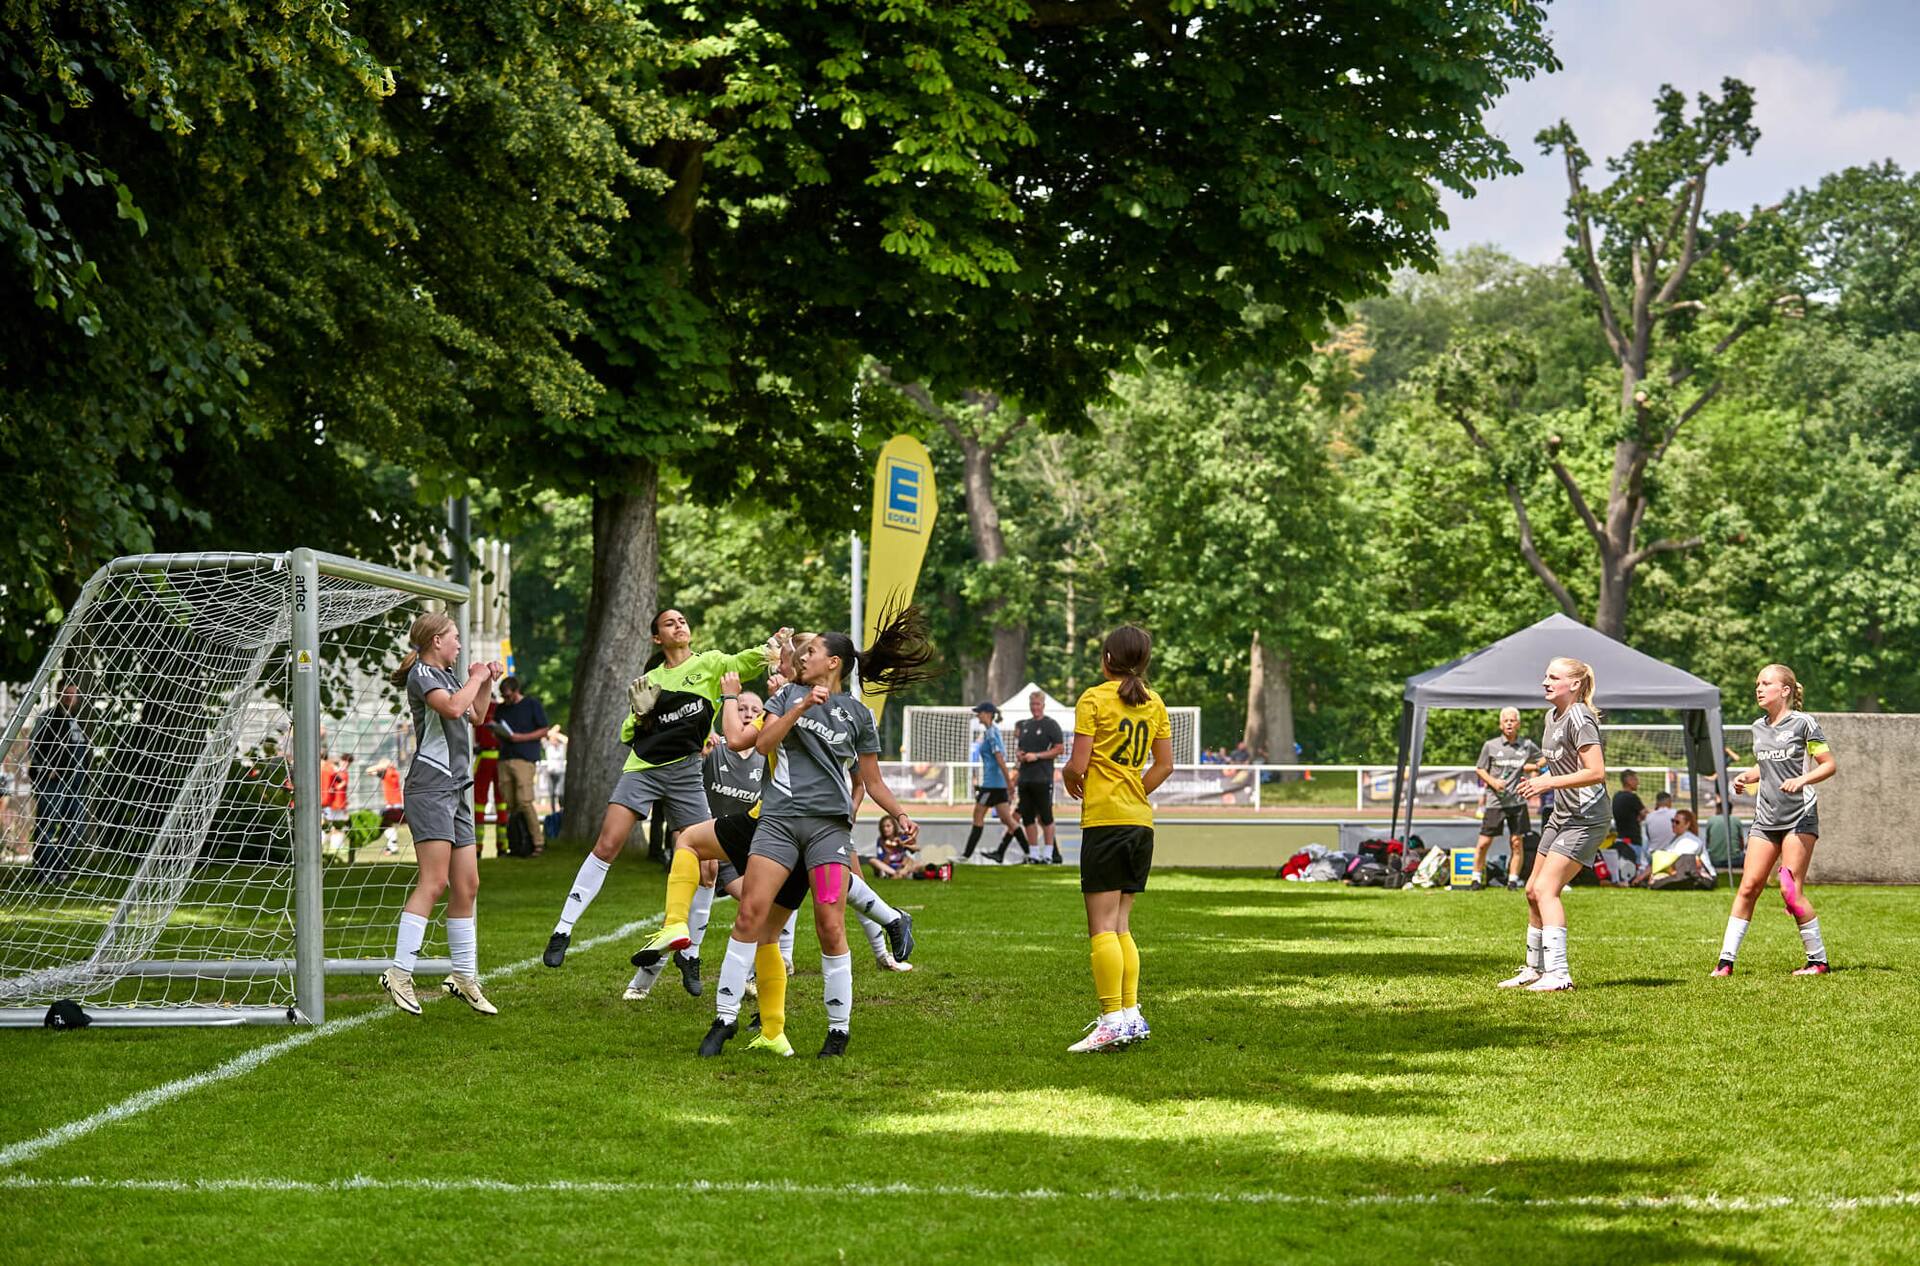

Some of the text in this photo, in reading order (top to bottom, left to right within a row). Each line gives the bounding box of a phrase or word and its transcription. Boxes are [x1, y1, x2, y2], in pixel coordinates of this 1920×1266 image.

[890, 465, 919, 514] E
[794, 716, 835, 742] AWITA
[1110, 717, 1149, 768] 20
[1455, 853, 1475, 875] E
